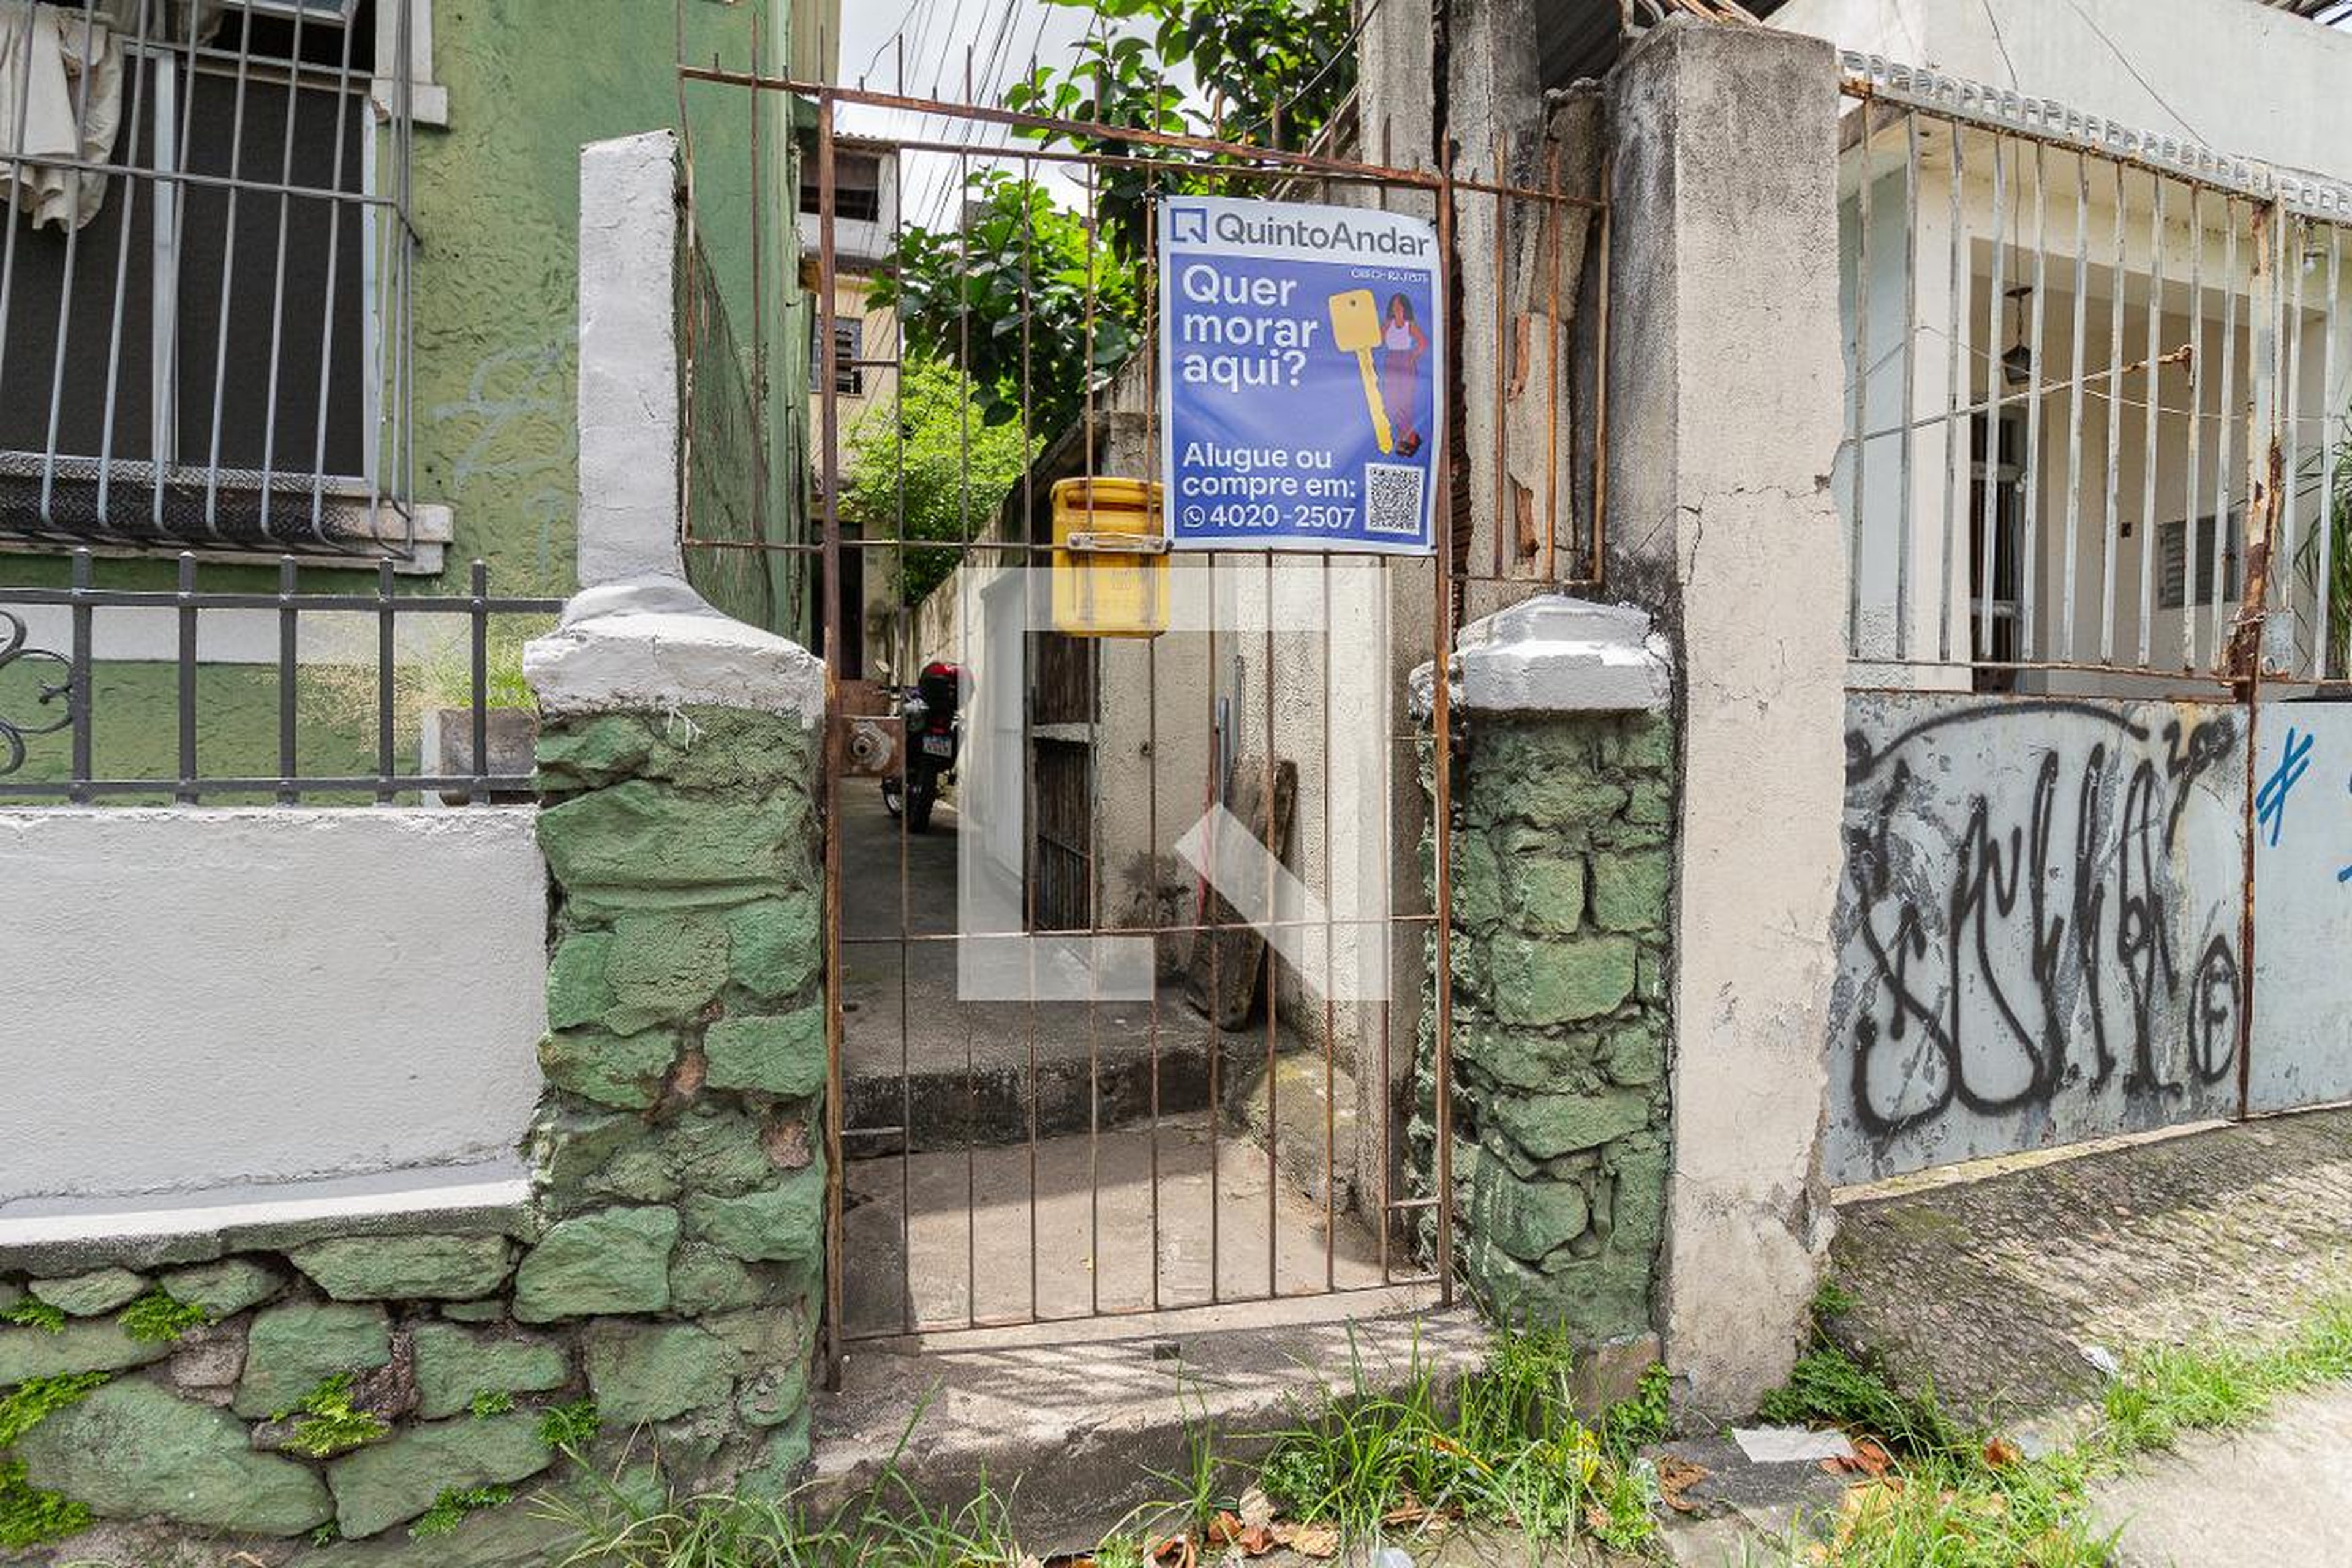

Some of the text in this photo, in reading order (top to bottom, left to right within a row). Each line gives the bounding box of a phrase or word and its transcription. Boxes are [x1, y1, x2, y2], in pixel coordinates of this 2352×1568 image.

[1216, 213, 1430, 257] QuintoAndar
[1183, 264, 1297, 306] Quer
[1183, 311, 1319, 348] morar
[1183, 349, 1306, 393] aqui?
[1183, 442, 1332, 472] Alugue ou
[1182, 477, 1357, 501] compre em:
